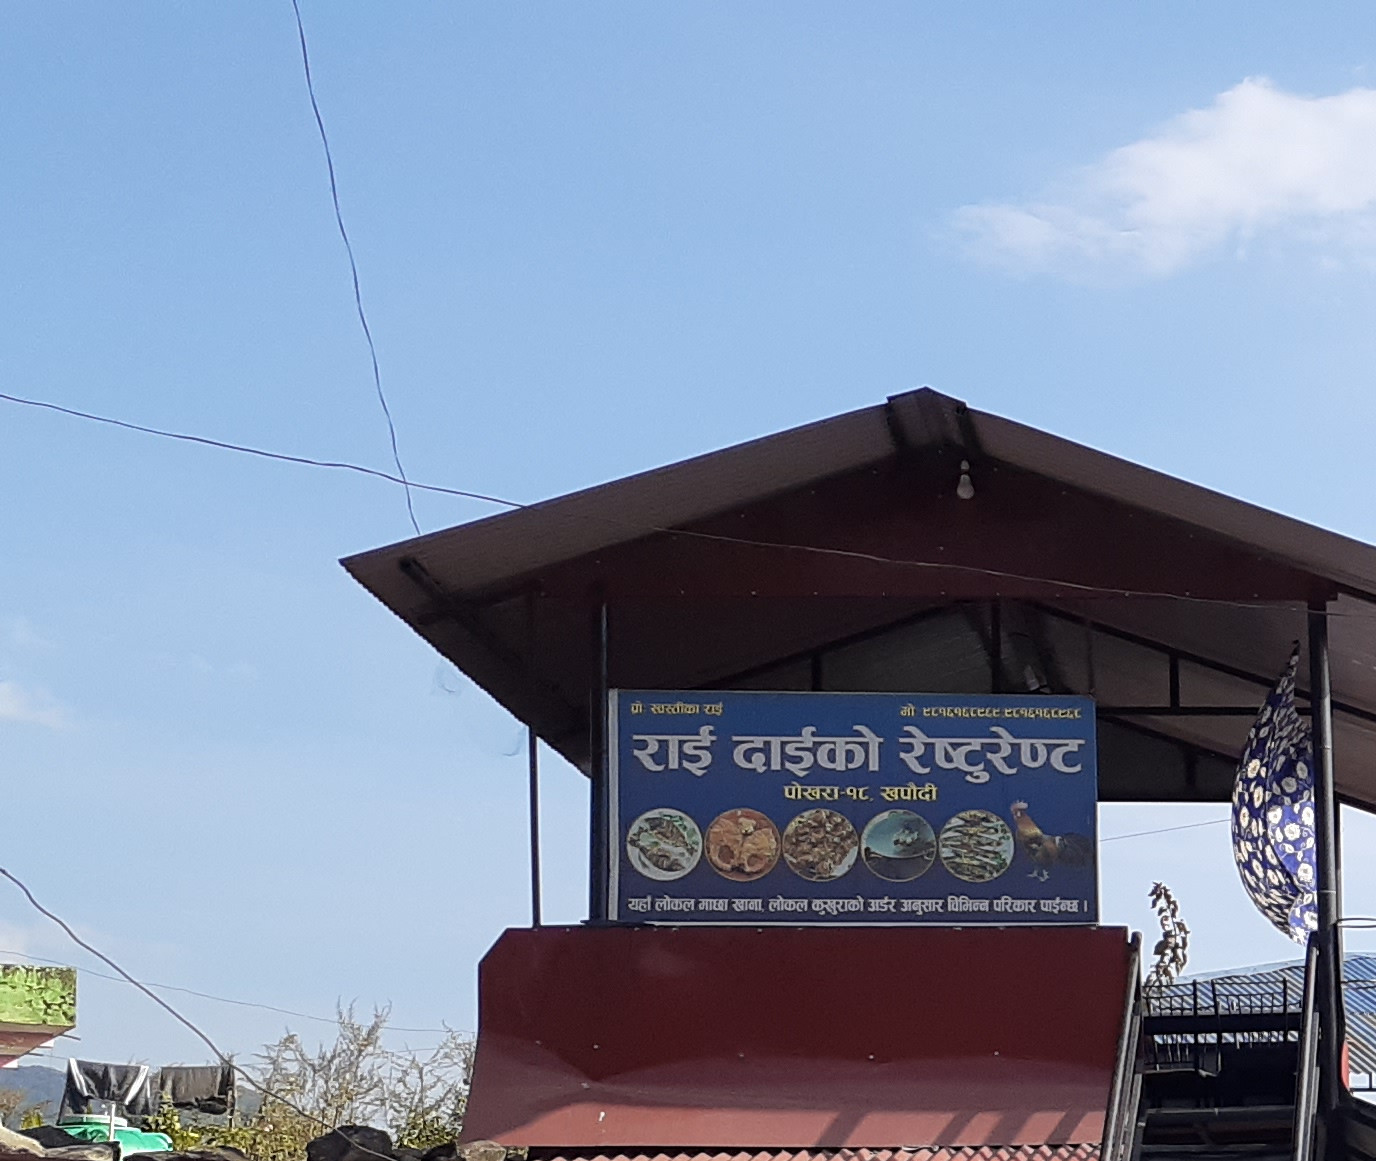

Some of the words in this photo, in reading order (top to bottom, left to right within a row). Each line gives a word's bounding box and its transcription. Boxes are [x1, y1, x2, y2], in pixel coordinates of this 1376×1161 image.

[632, 725, 717, 776] राई
[732, 725, 883, 777] दाईको
[899, 726, 1085, 784] रेष्टुरेण्ट
[880, 782, 938, 801] खपौदी
[655, 895, 695, 911] लोकल
[769, 895, 808, 911] लोकल
